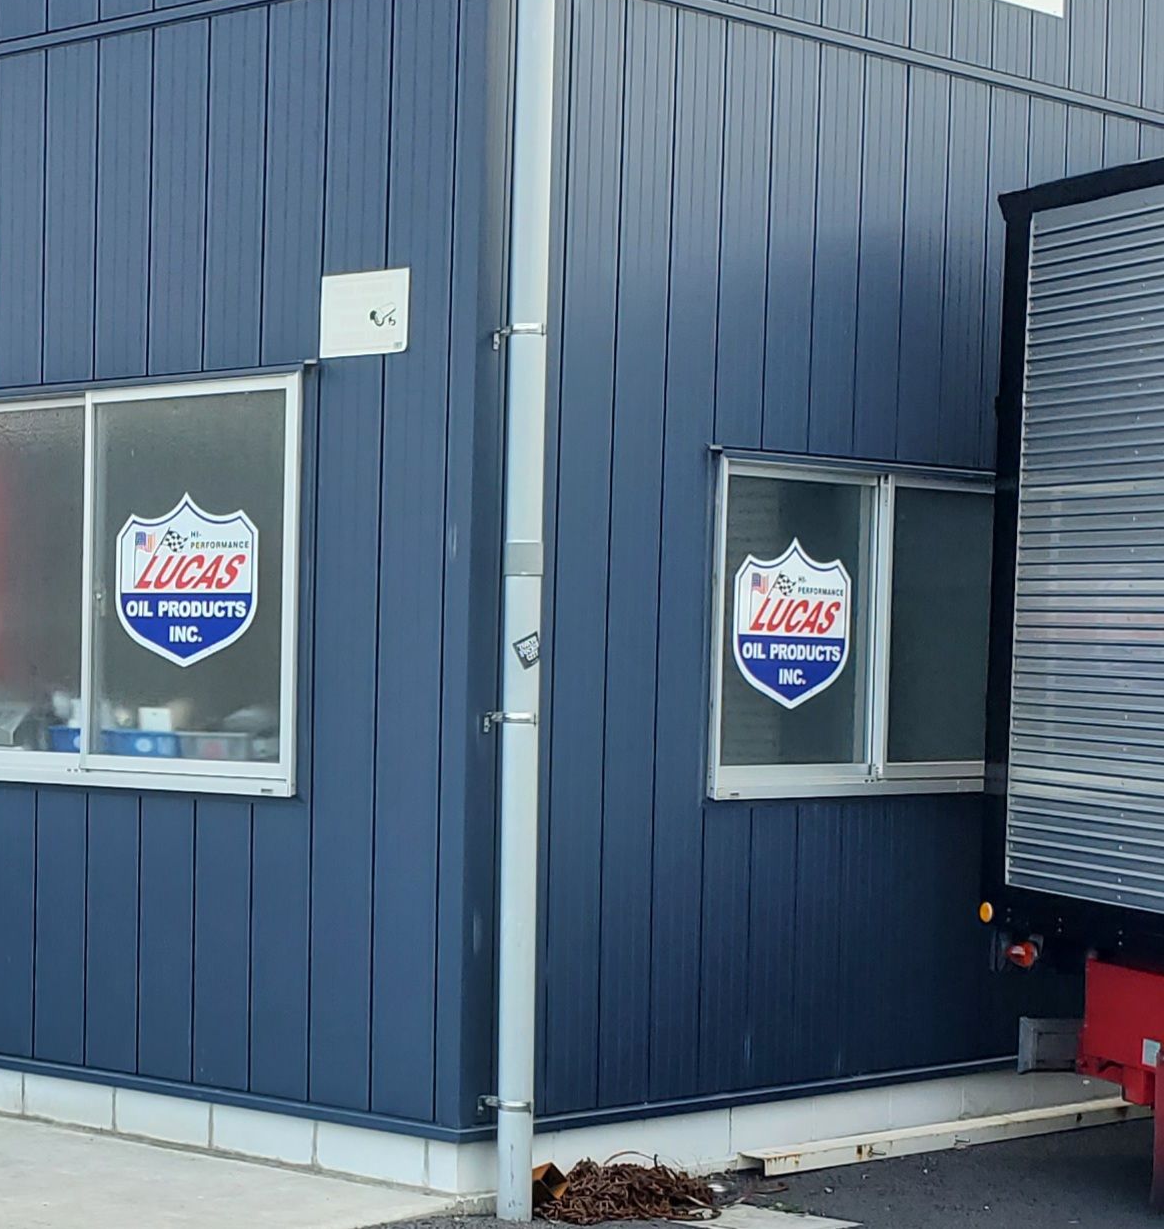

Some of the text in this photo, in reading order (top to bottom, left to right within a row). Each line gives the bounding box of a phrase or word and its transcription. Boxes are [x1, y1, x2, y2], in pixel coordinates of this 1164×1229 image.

[190, 541, 250, 549] PERFORMANCE
[134, 554, 246, 589] LUCAS
[798, 586, 844, 596] PERFORMANCE
[126, 600, 247, 618] OIL PRODUCTS
[749, 597, 841, 634] LUCAS
[169, 625, 203, 643] INC.
[742, 642, 841, 662] OIL PRODUCTS
[778, 668, 807, 685] INC.
